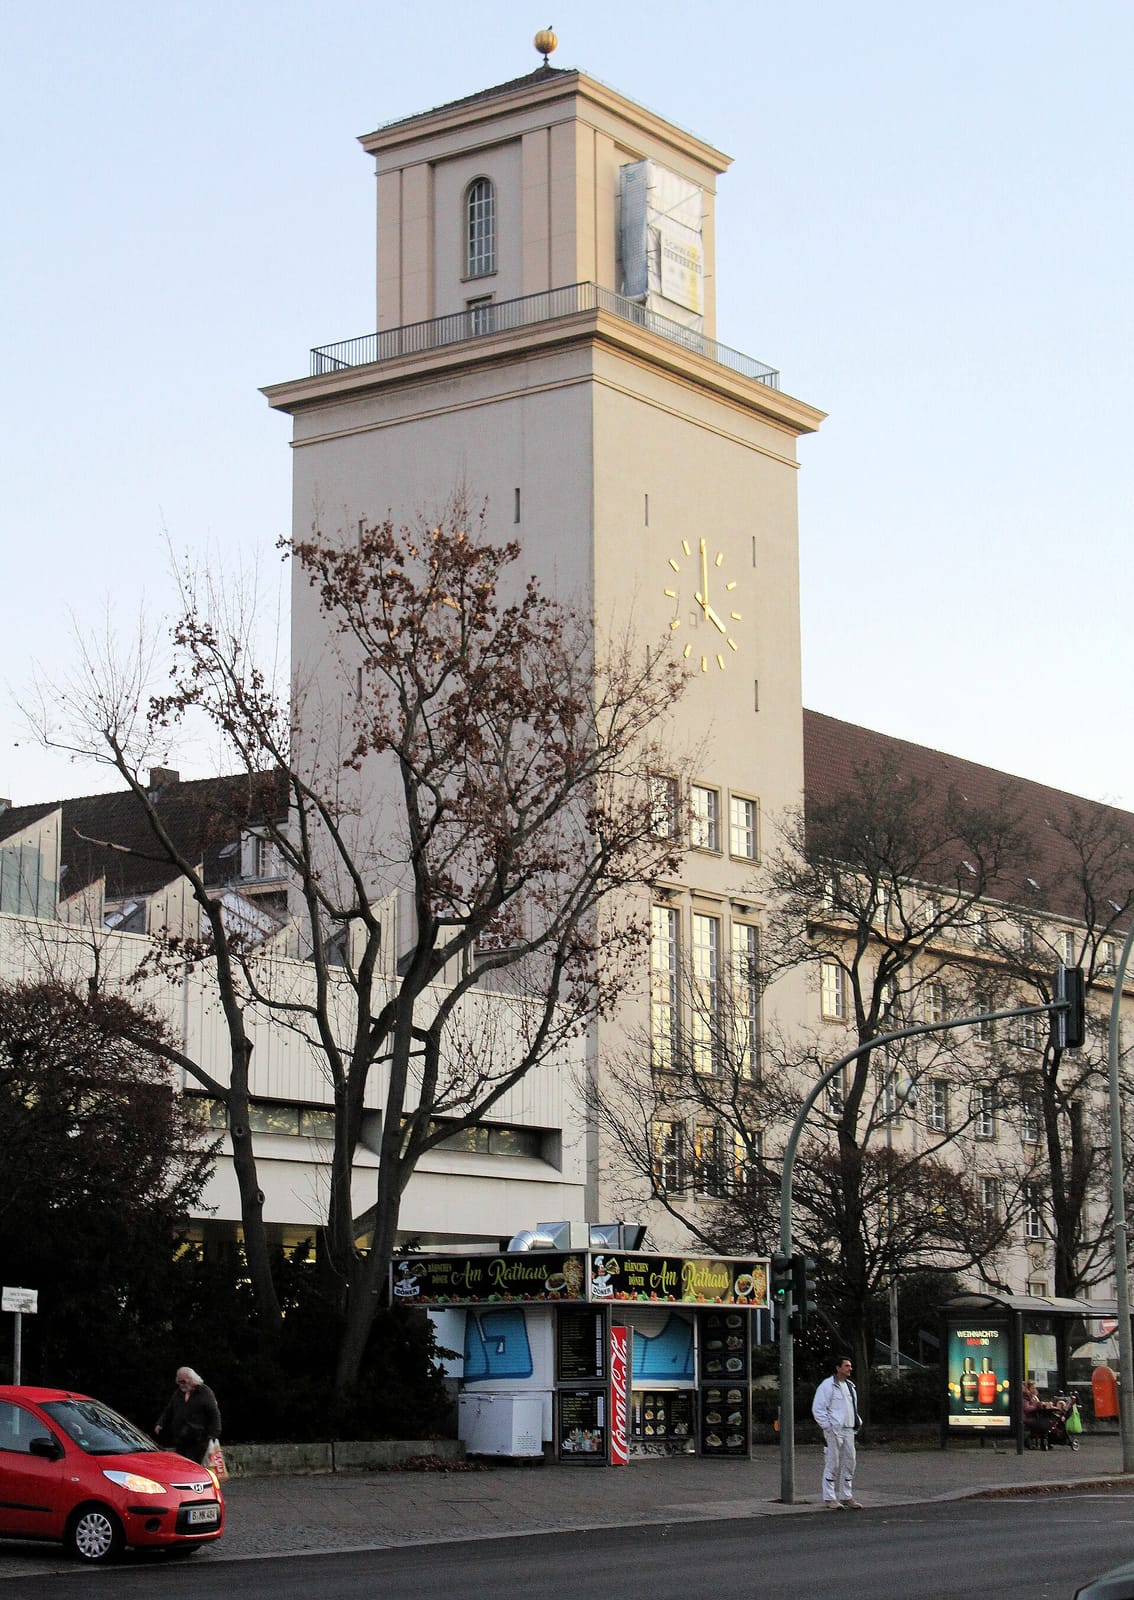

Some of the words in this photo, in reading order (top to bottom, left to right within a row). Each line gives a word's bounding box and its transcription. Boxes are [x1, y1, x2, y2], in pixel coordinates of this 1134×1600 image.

[450, 1260, 483, 1289] Am
[488, 1258, 551, 1289] Rathaus
[649, 1261, 677, 1294] Am
[681, 1261, 730, 1296] Rathaus
[956, 1330, 999, 1338] WEIHNACHTS
